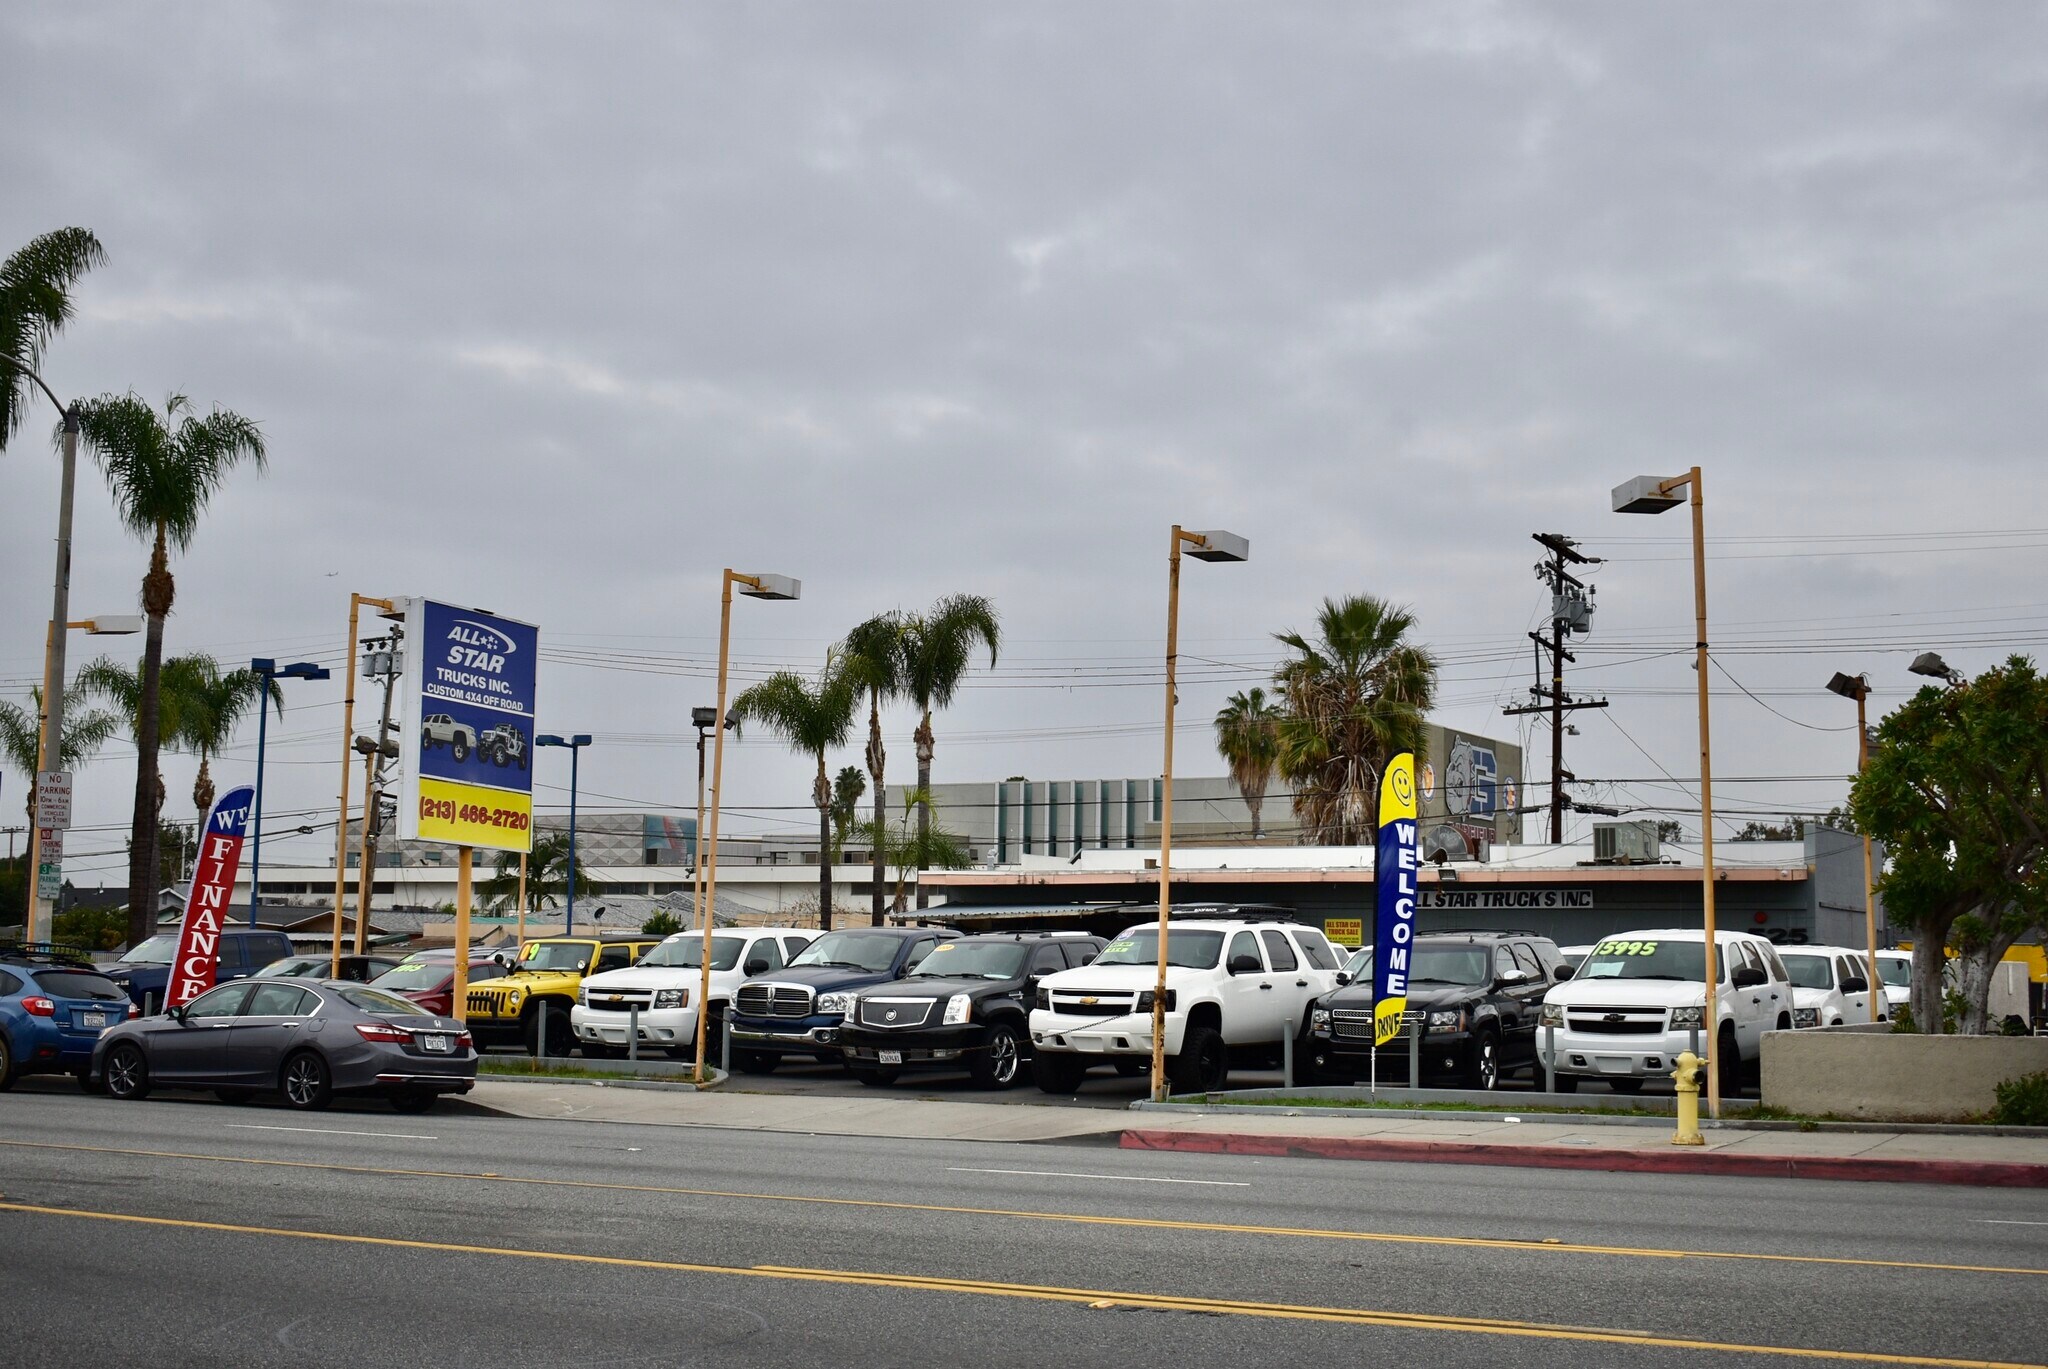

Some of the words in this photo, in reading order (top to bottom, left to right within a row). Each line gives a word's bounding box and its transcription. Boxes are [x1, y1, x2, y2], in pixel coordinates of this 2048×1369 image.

[447, 626, 480, 646] ALL
[447, 646, 505, 674] STAR
[437, 667, 486, 689] TRUCKS
[489, 679, 512, 695] INC.
[427, 683, 463, 699] CUSTOM
[465, 692, 481, 703] 4X4
[483, 695, 499, 707] OFF
[500, 699, 523, 711] ROAD
[49, 775, 62, 783] NO
[40, 786, 71, 795] PARKING
[216, 806, 248, 830] WE
[419, 796, 456, 824] (213)
[459, 804, 528, 830] 466-2720
[42, 865, 48, 874] 3
[1387, 823, 1415, 995] WELCOME
[1434, 892, 1478, 907] STAR
[1561, 891, 1591, 906] INC
[177, 837, 234, 1001] FINANCE
[520, 943, 540, 961] 09
[1592, 941, 1658, 956] 15995
